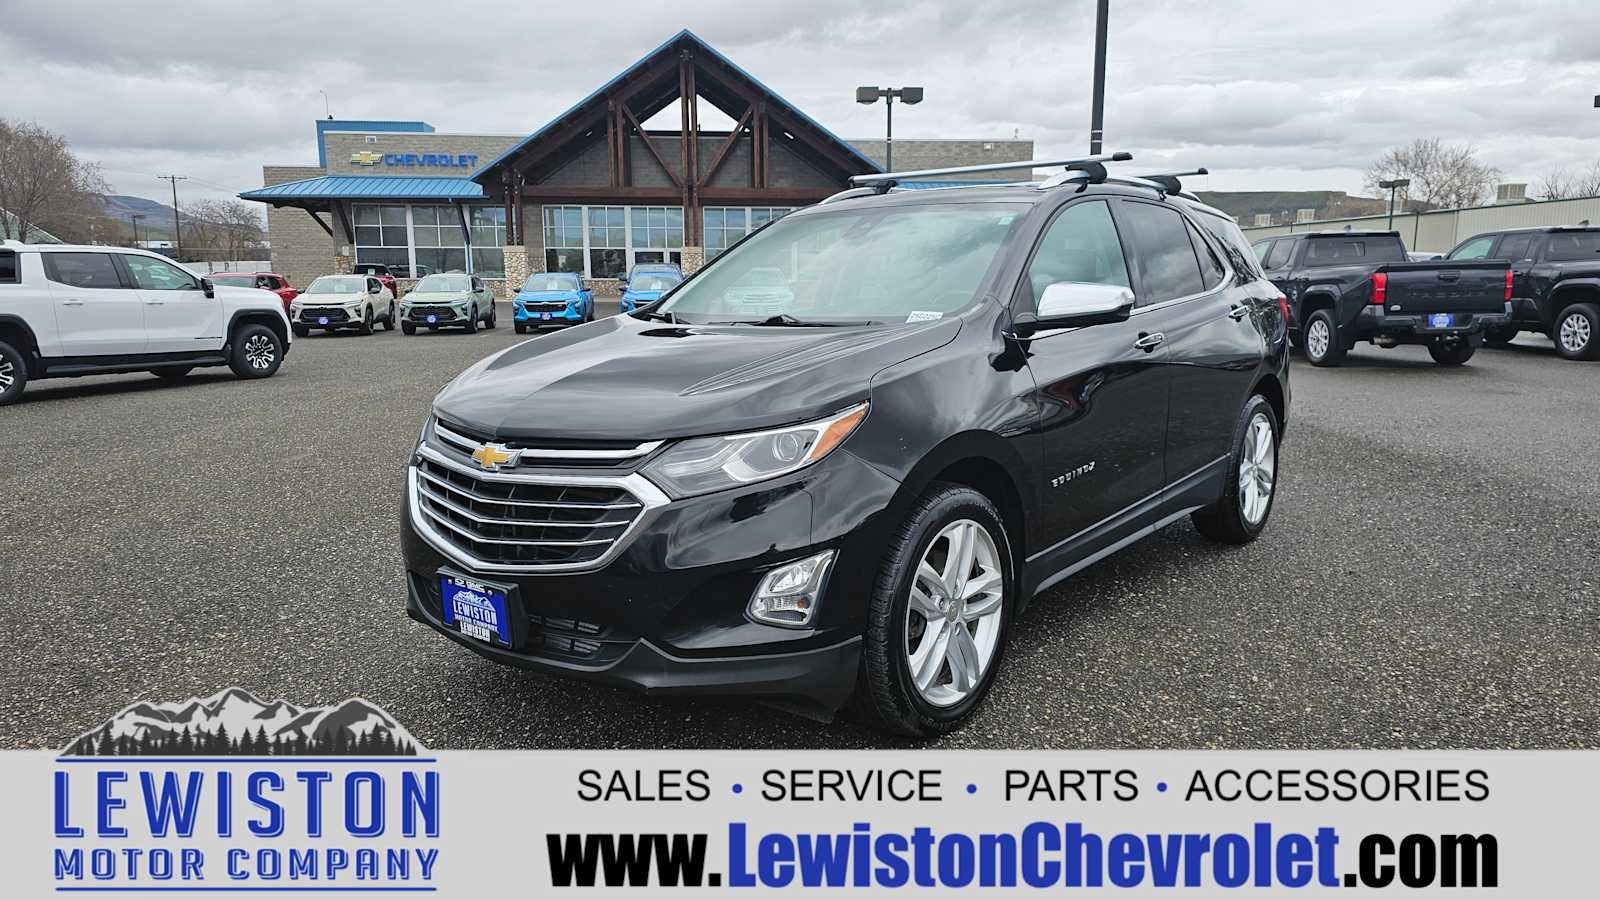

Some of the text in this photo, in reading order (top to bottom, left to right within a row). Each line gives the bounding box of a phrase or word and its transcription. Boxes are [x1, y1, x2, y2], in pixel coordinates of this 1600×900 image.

[384, 153, 478, 167] CHEVROLET
[453, 600, 498, 626] LEWISTON
[460, 621, 491, 639] LEWISTON
